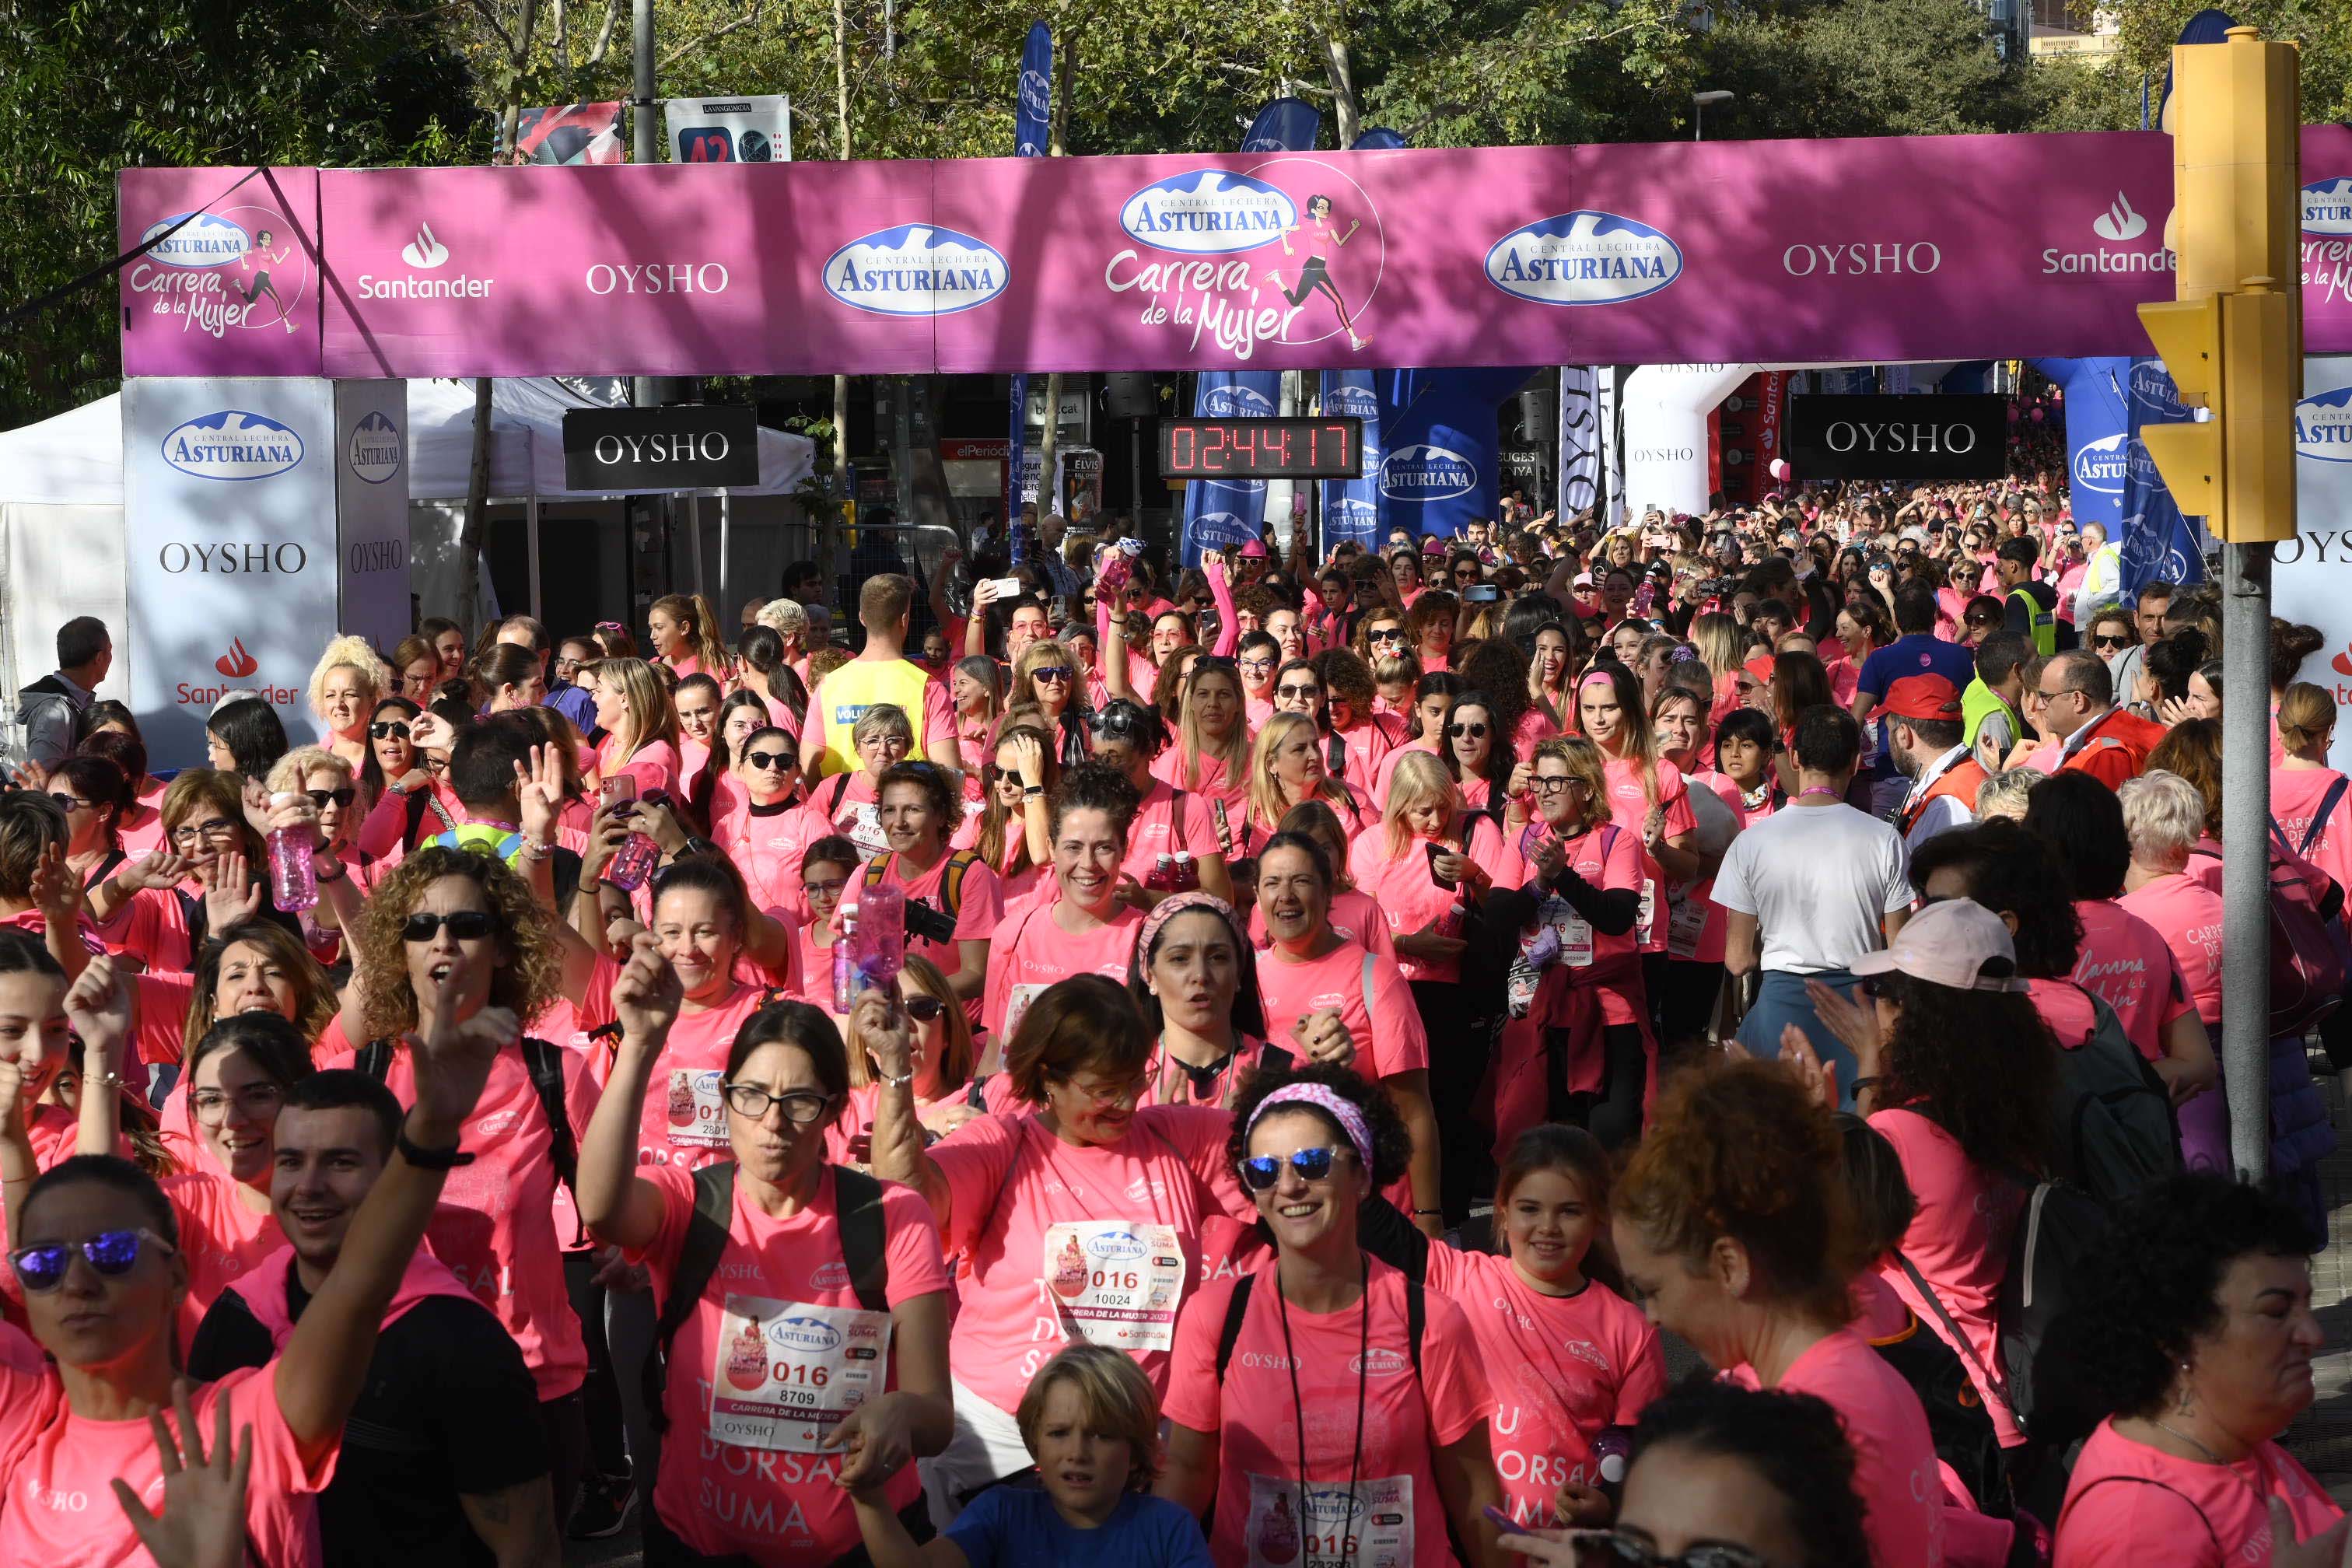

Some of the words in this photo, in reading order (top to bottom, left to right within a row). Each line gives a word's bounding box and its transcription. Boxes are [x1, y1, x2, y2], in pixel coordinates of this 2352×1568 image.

[1160, 198, 1217, 208] CENTRAL
[1221, 197, 1278, 207] LECHERA
[1133, 201, 1282, 233] ASTURIANA
[149, 233, 241, 254] ASTURIANA
[1530, 243, 1592, 254] CENTRAL
[1597, 241, 1661, 252] LECHERA
[866, 256, 925, 265] CENTRAL
[931, 254, 989, 264] LECHERA
[1500, 247, 1668, 282] ASTURIANA
[1783, 242, 1941, 276] OYSHO
[131, 264, 223, 293] Carrera
[586, 263, 729, 295] OYSHO
[838, 257, 995, 292] ASTURIANA
[1105, 250, 1251, 293] Carrera
[359, 275, 494, 299] Santander
[153, 295, 170, 314] de
[173, 295, 186, 314] la
[184, 291, 257, 338] Mujer
[1140, 296, 1167, 325] de
[1174, 294, 1193, 325] la
[1189, 285, 1304, 360] Mujer
[173, 436, 294, 463] ASTURIANA
[594, 432, 730, 464] OYSHO
[1172, 427, 1346, 469] 02:44:17
[1825, 422, 1976, 453] OYSHO
[352, 439, 398, 467] ASTURIANA
[1075, 460, 1098, 470] ELVIS
[1633, 447, 1694, 463] OYSHO
[1382, 467, 1470, 488] ASTURIANA
[159, 542, 306, 574] OYSHO
[351, 539, 402, 574] OYSHO
[702, 1125, 727, 1135] 2801
[1091, 1240, 1143, 1255] ASTURIANA
[1092, 1270, 1138, 1289] 016
[1094, 1293, 1131, 1306] 10024
[1096, 1309, 1107, 1318] DE
[1108, 1310, 1120, 1319] LA
[775, 1326, 835, 1346] ASTURIANA
[772, 1362, 828, 1387] 016
[779, 1390, 815, 1405] 8709
[731, 1403, 776, 1416] CARRERA
[778, 1409, 791, 1417] DE
[793, 1410, 807, 1419] LA
[724, 1420, 775, 1438] OYSHO
[700, 1476, 810, 1535] SUMA
[1306, 1535, 1358, 1555] 016
